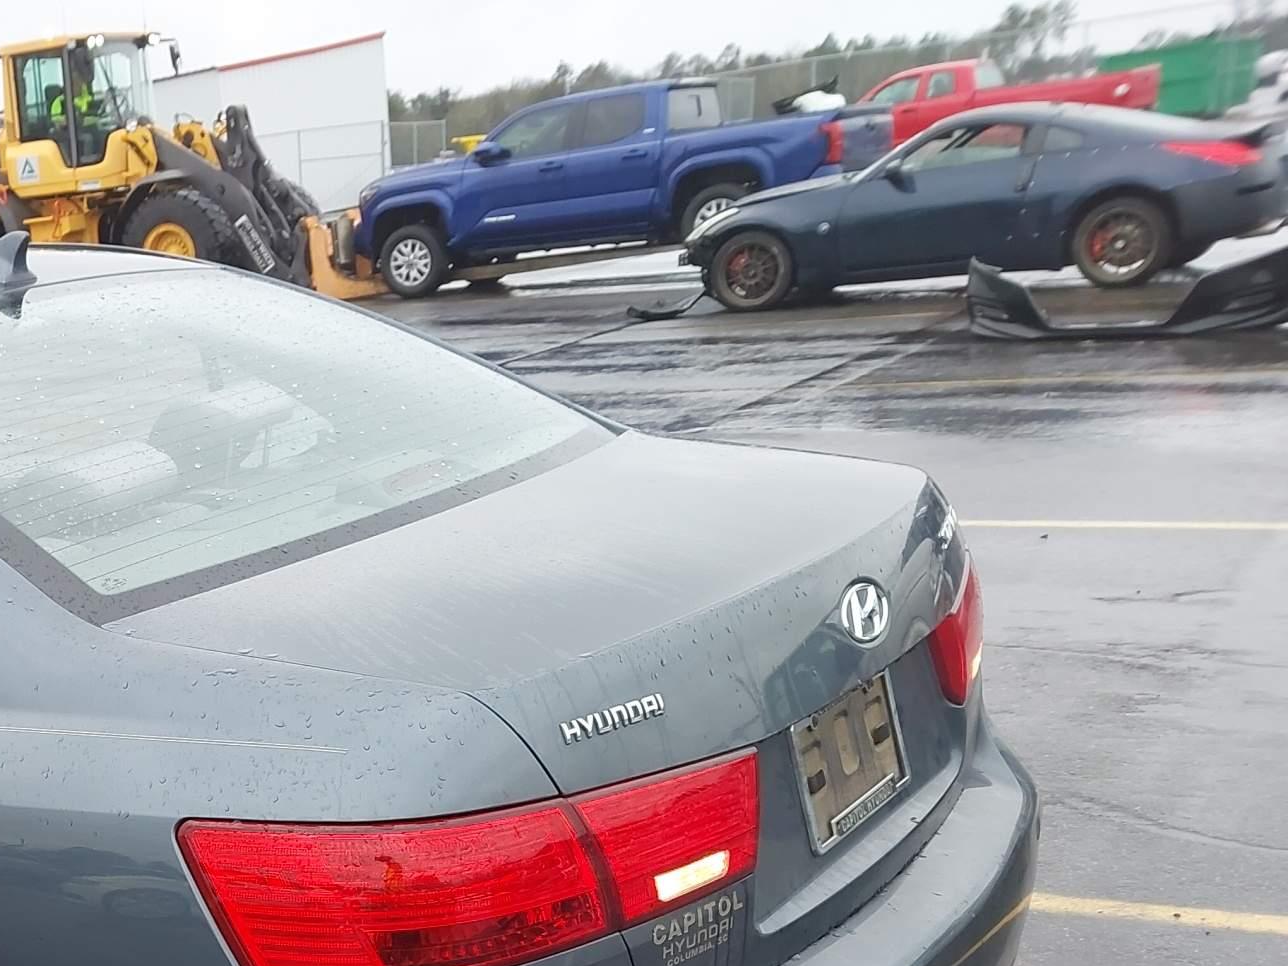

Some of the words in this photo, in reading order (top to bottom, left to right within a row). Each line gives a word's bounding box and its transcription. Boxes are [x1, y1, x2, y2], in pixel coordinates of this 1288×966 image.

[559, 692, 665, 745] HYUNDAI
[653, 890, 744, 945] CAPITOL
[662, 916, 733, 959] HYUNDAI
